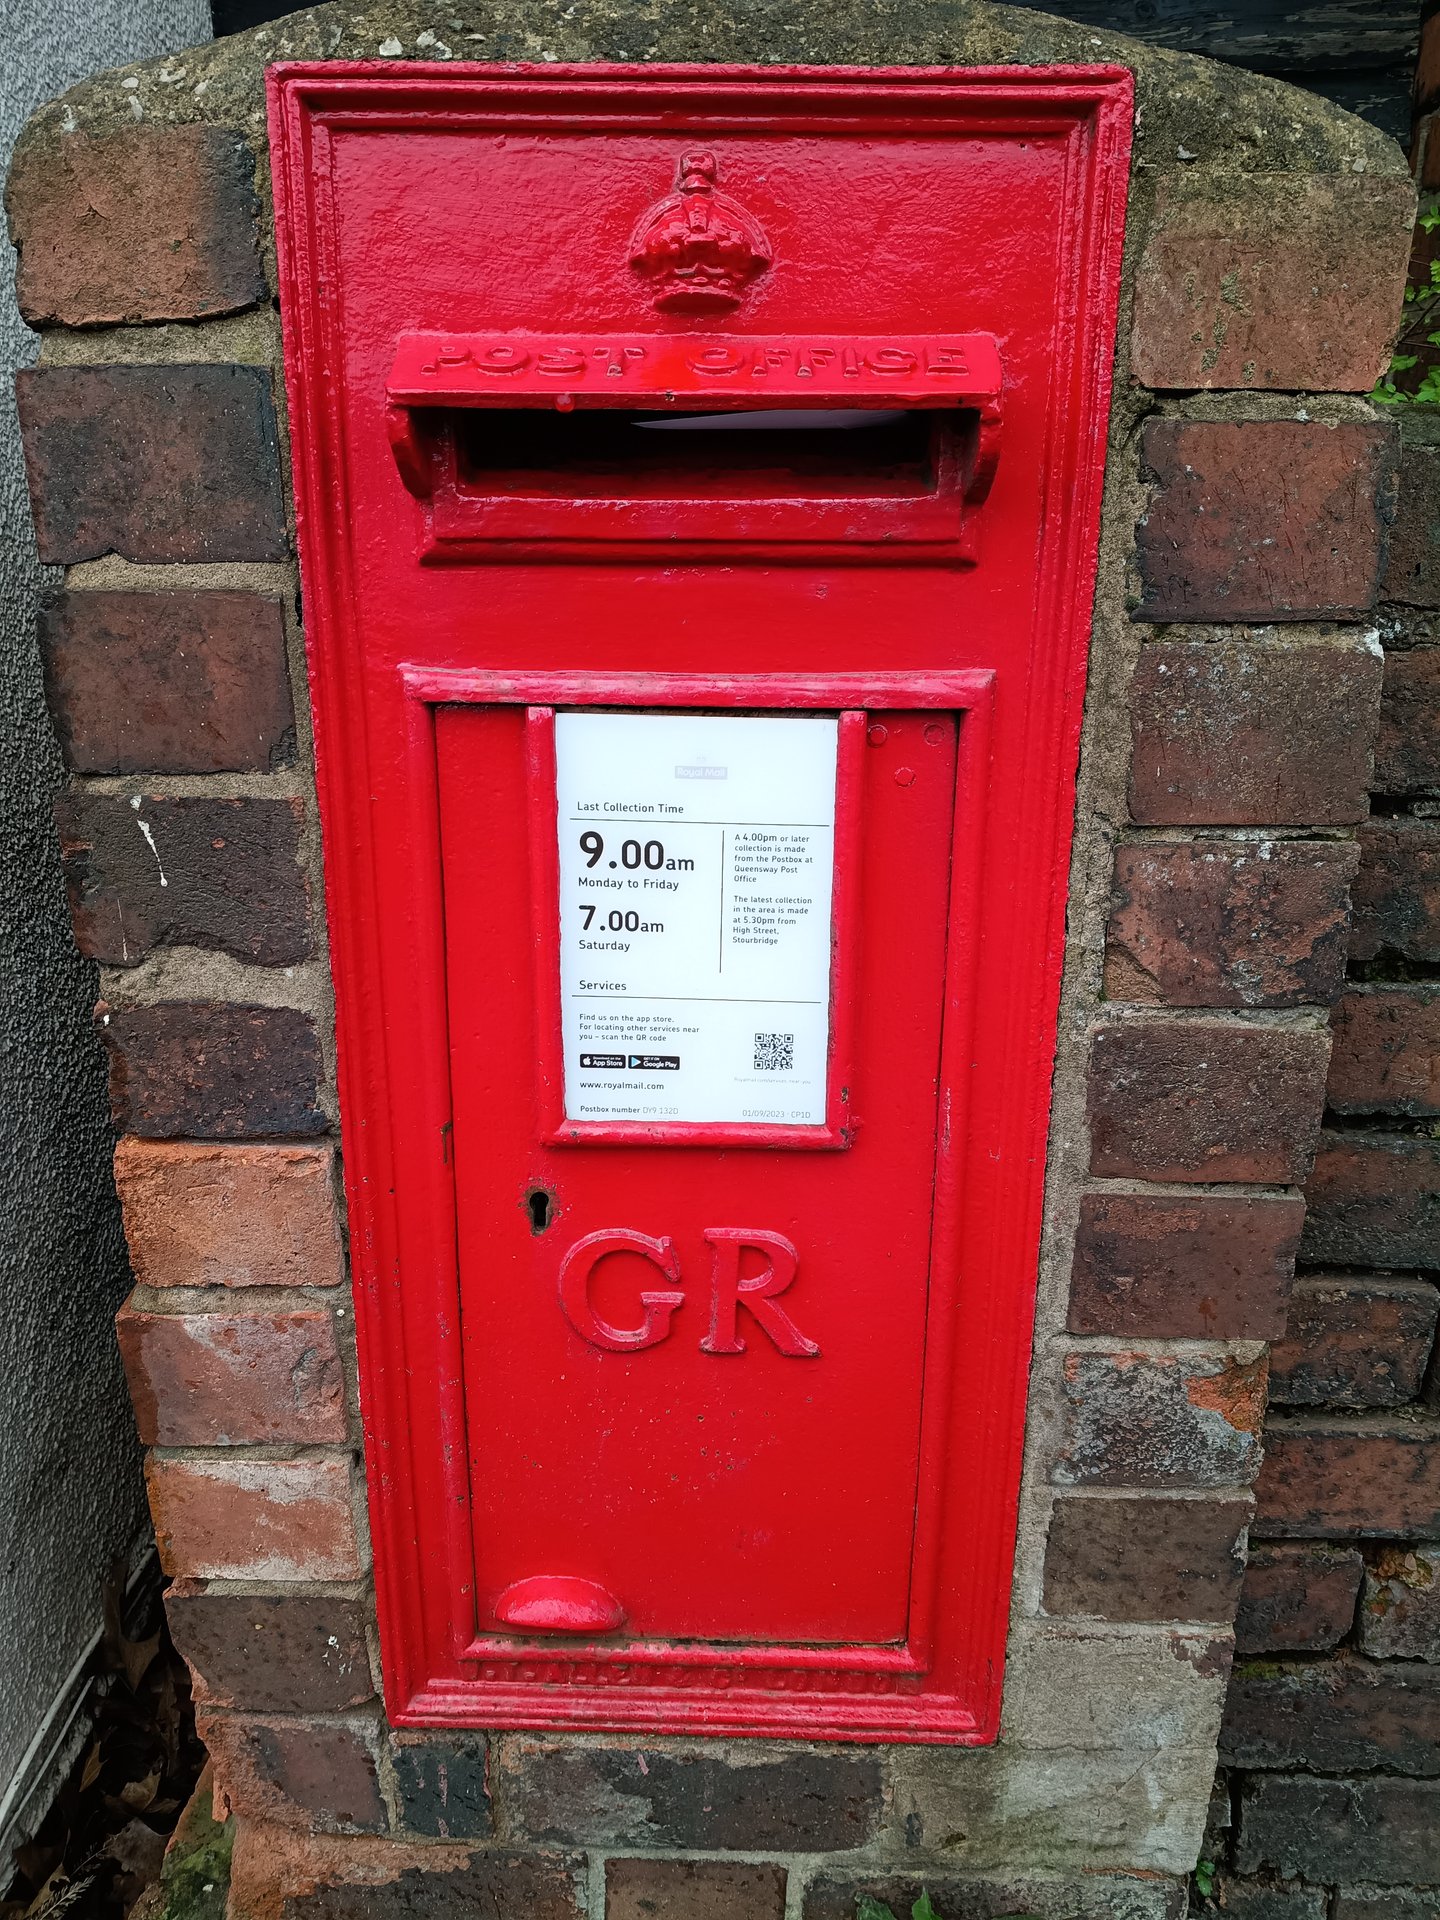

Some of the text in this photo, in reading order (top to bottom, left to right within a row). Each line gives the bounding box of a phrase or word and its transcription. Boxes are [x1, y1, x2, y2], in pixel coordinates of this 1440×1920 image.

[420, 345, 971, 377] POST OFFICE
[677, 767, 725, 778] Royal Mail
[578, 801, 683, 813] Last Collection Time
[743, 833, 777, 844] 4.00pm
[580, 831, 694, 871] 9.00am
[735, 844, 772, 852] collection
[735, 865, 778, 875] Queensway
[579, 877, 679, 891] Monday to Friday
[579, 905, 663, 932] 7.00am
[744, 916, 774, 926] 5.30pm
[733, 926, 750, 935] High
[733, 936, 778, 945] Stourbridge
[579, 940, 630, 952] Saturday
[580, 980, 626, 990] Services
[594, 1024, 624, 1032] locating
[665, 1061, 677, 1069] Play
[580, 1082, 664, 1090] www.royalmail.com
[742, 1109, 785, 1118] 01/09/2023
